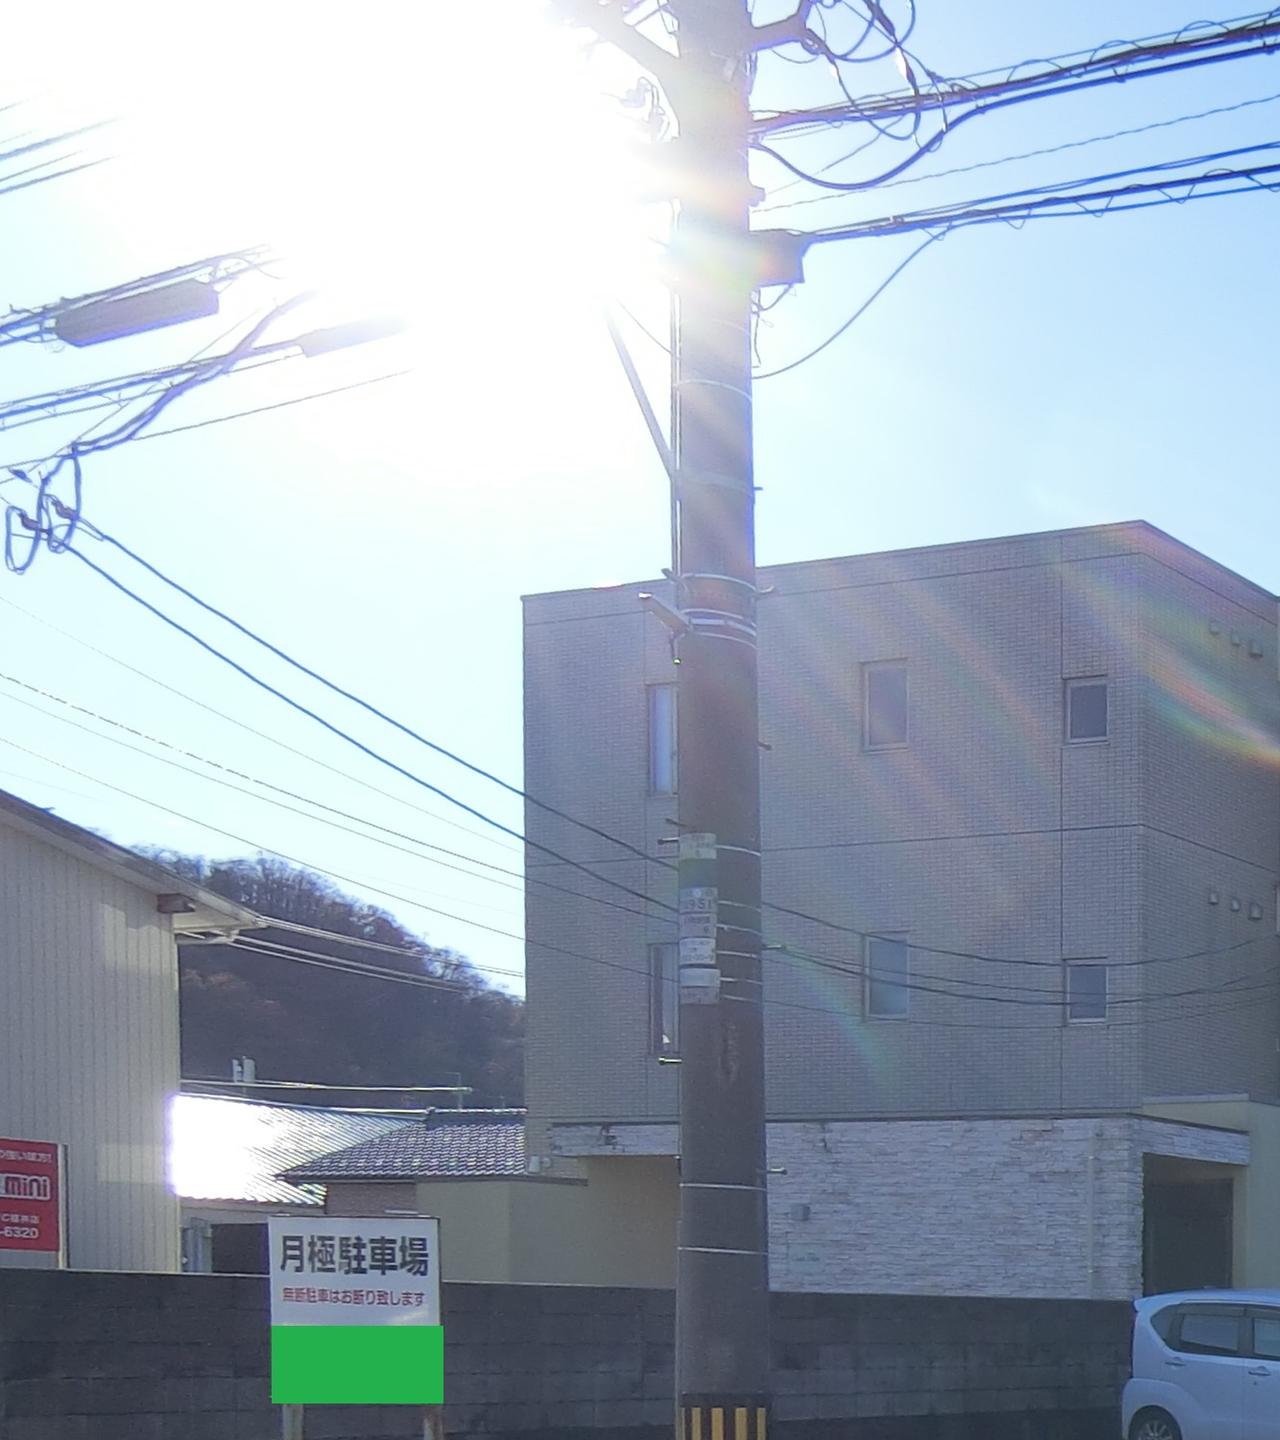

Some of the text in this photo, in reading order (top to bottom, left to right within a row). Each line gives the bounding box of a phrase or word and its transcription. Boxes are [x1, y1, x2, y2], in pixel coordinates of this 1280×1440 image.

[5, 1176, 48, 1197] mini
[280, 1235, 429, 1276] 月極駐車場
[283, 1287, 425, 1307] 無断駐車はお断り致します
